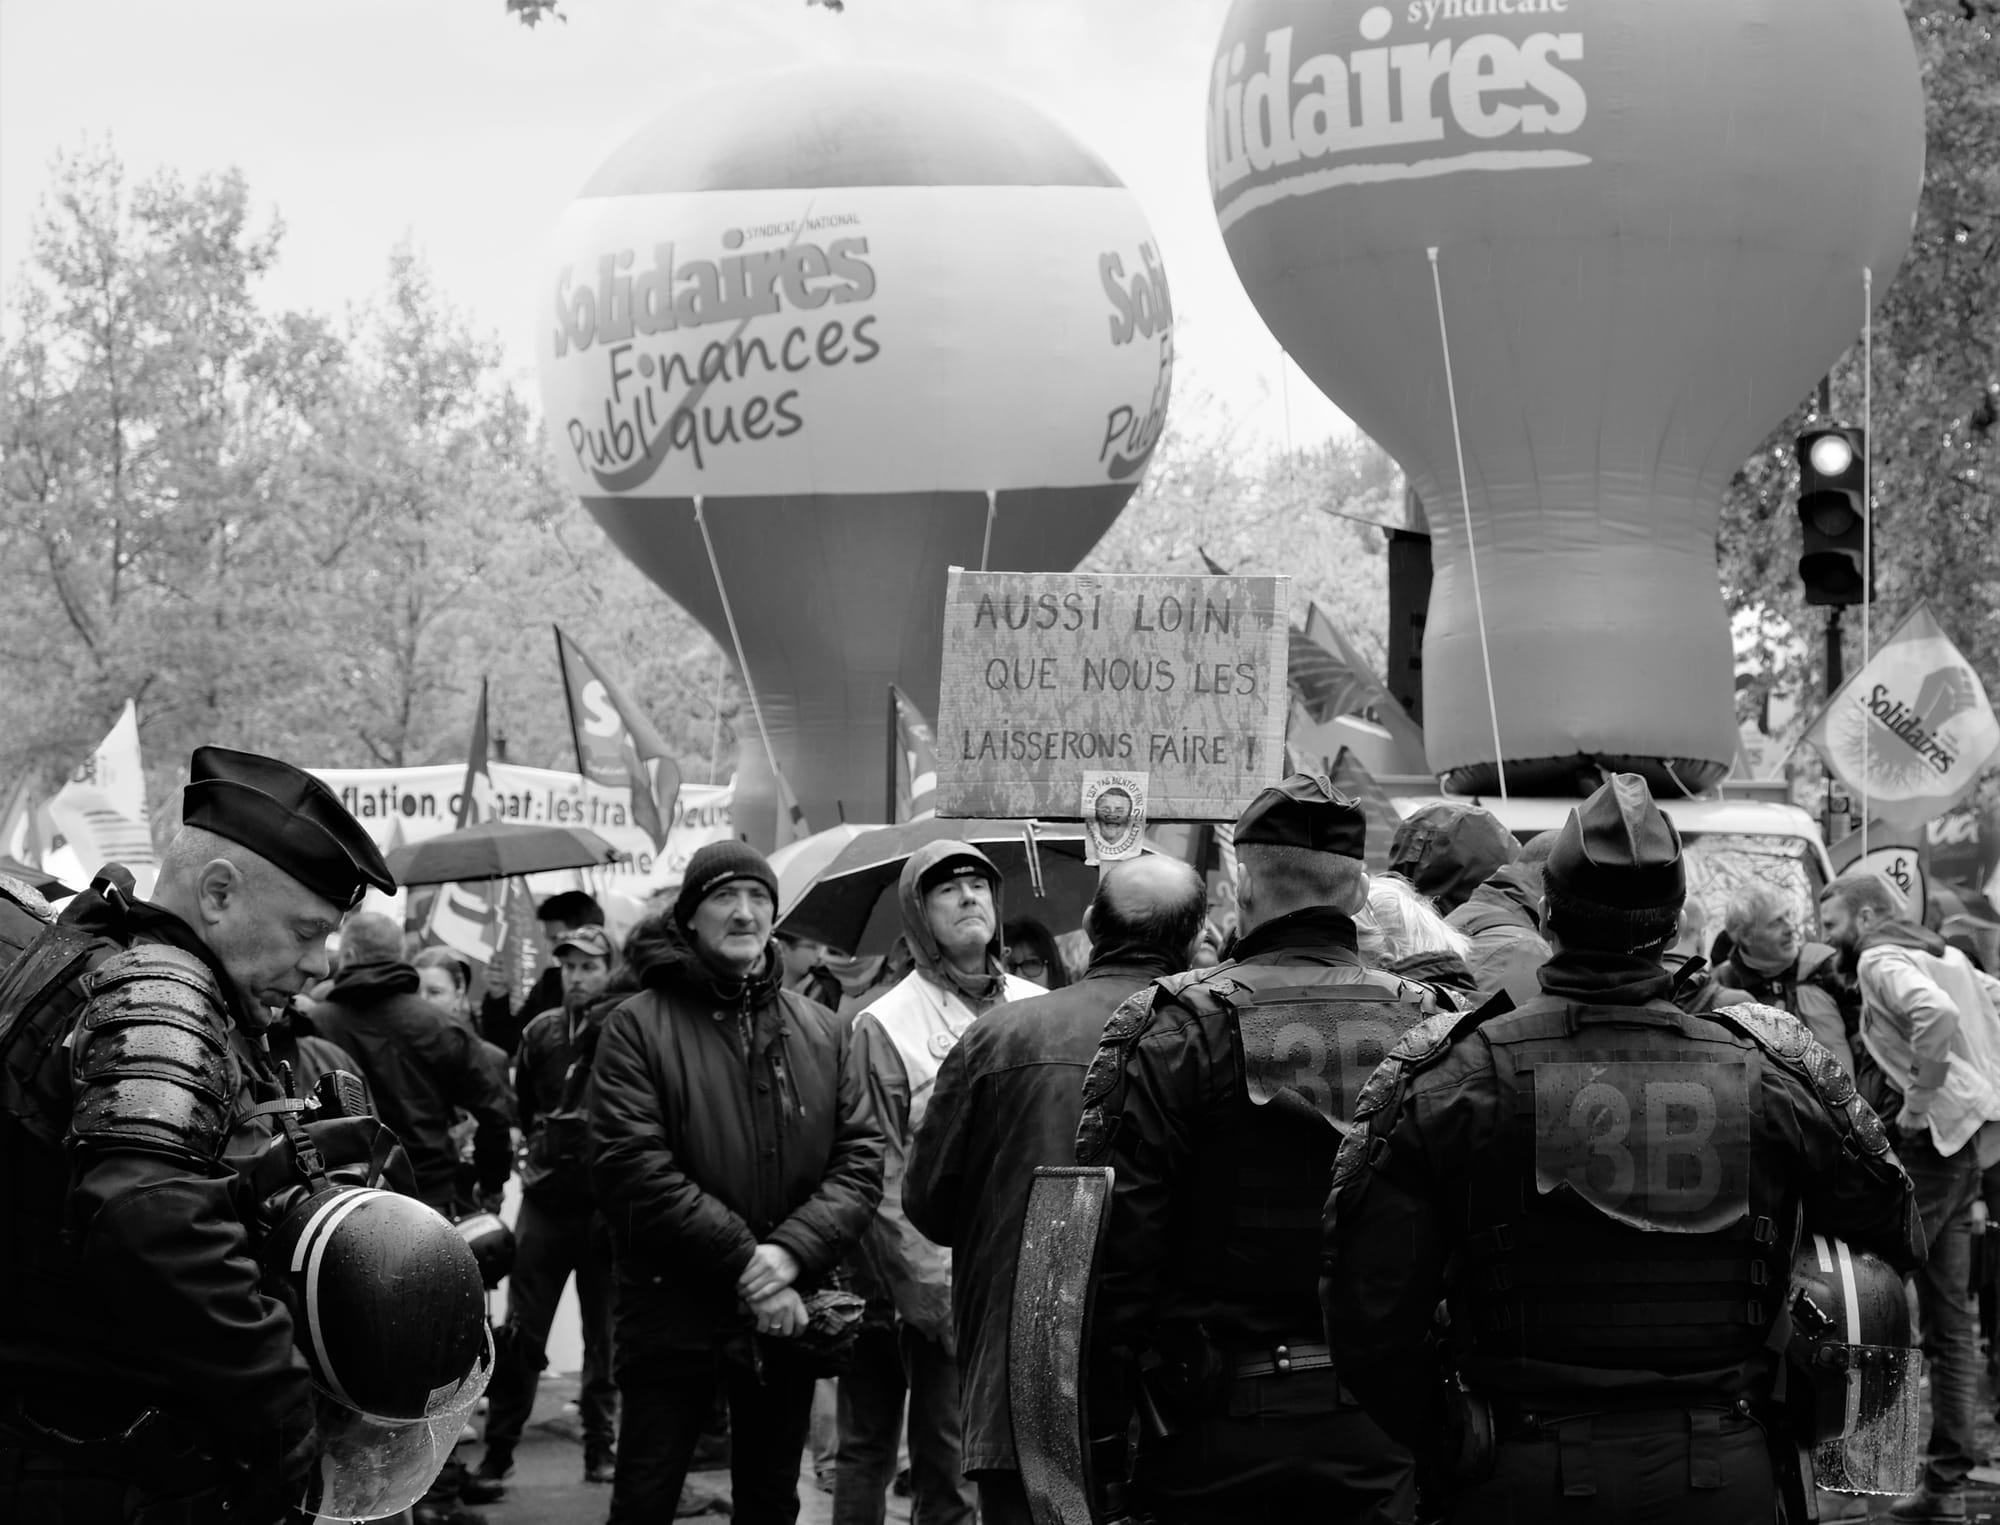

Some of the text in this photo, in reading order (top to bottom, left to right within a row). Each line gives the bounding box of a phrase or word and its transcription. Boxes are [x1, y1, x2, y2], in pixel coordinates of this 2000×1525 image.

[1208, 6, 1588, 191] lidaires
[747, 212, 860, 239] SYNDICAT NATIONAL
[554, 228, 875, 358] Solidaires
[609, 314, 880, 404] Finances
[985, 657, 1257, 696] QUE NOUS LES
[1861, 684, 1955, 774] Solidaires
[341, 784, 443, 822] flation,
[1568, 1081, 1722, 1212] 3B
